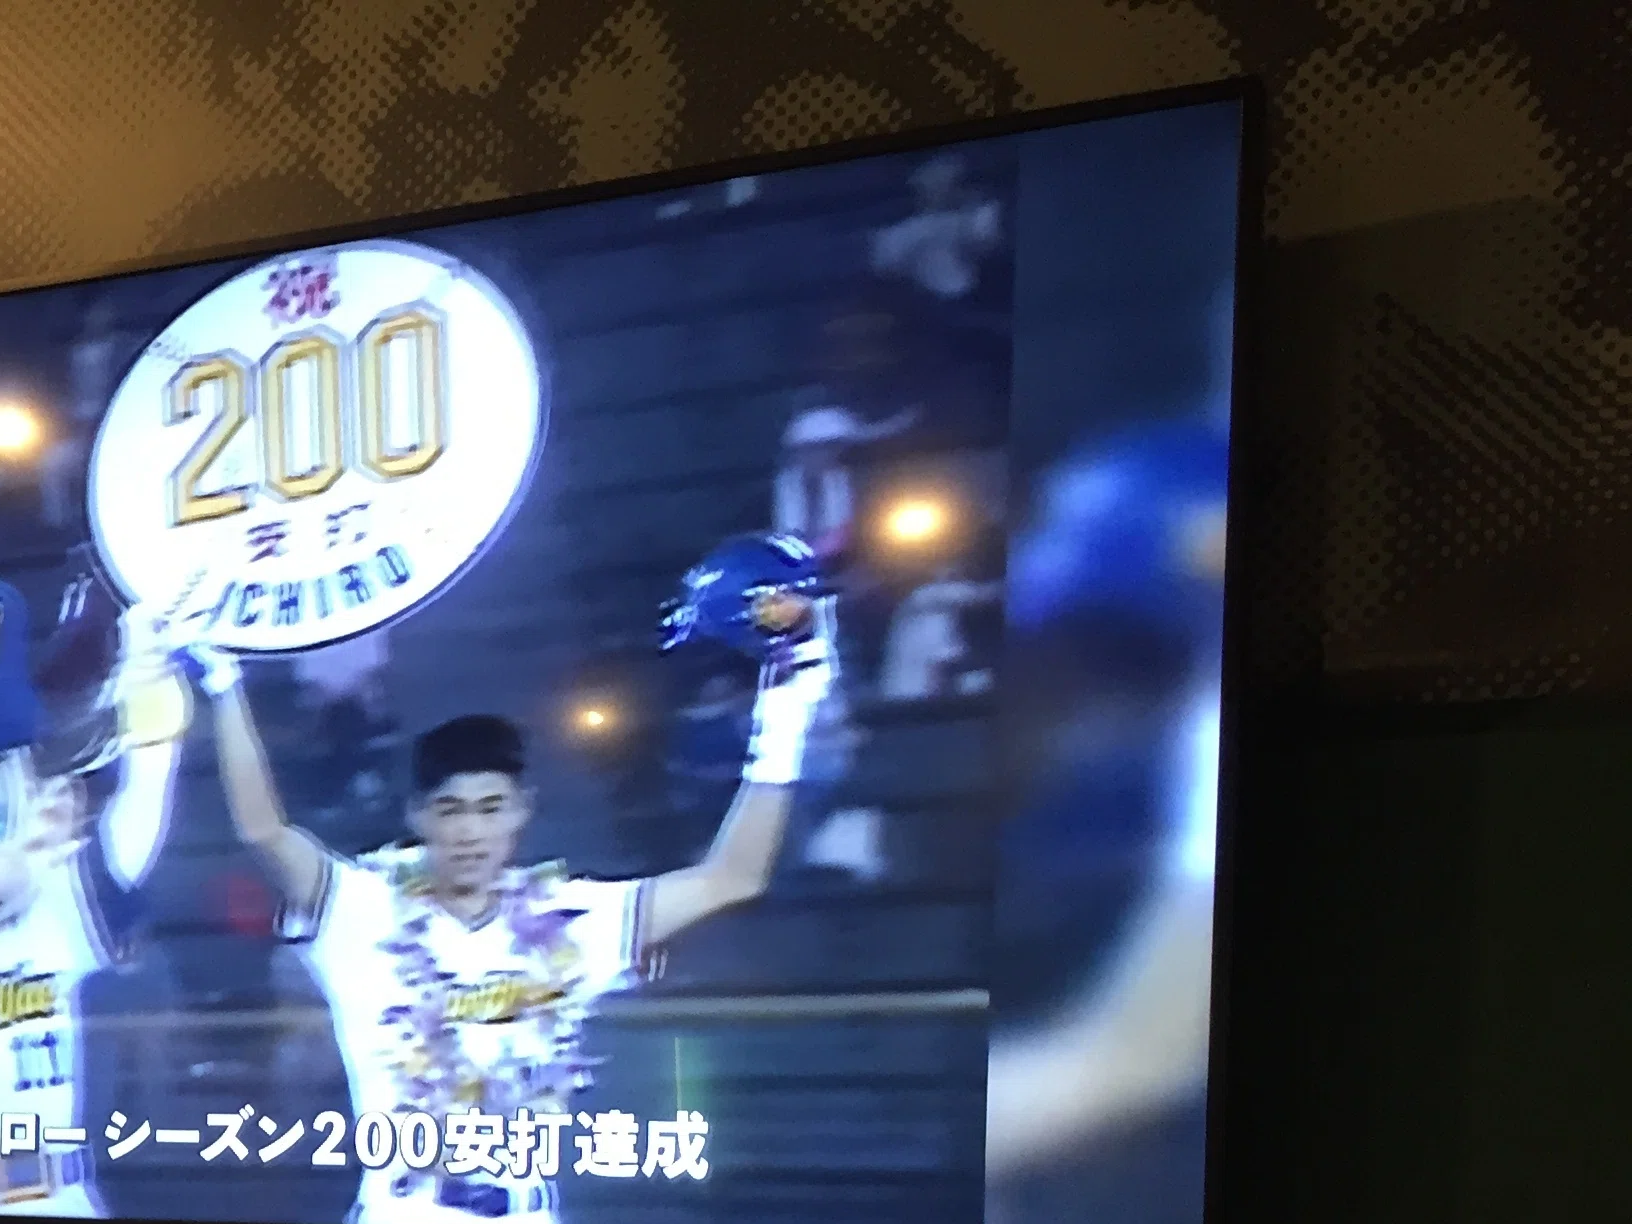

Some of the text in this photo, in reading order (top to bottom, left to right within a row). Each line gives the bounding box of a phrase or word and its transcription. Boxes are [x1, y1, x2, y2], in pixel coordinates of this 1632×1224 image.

[162, 298, 449, 529] 200
[104, 1103, 710, 1181] シーズン200安打達成
